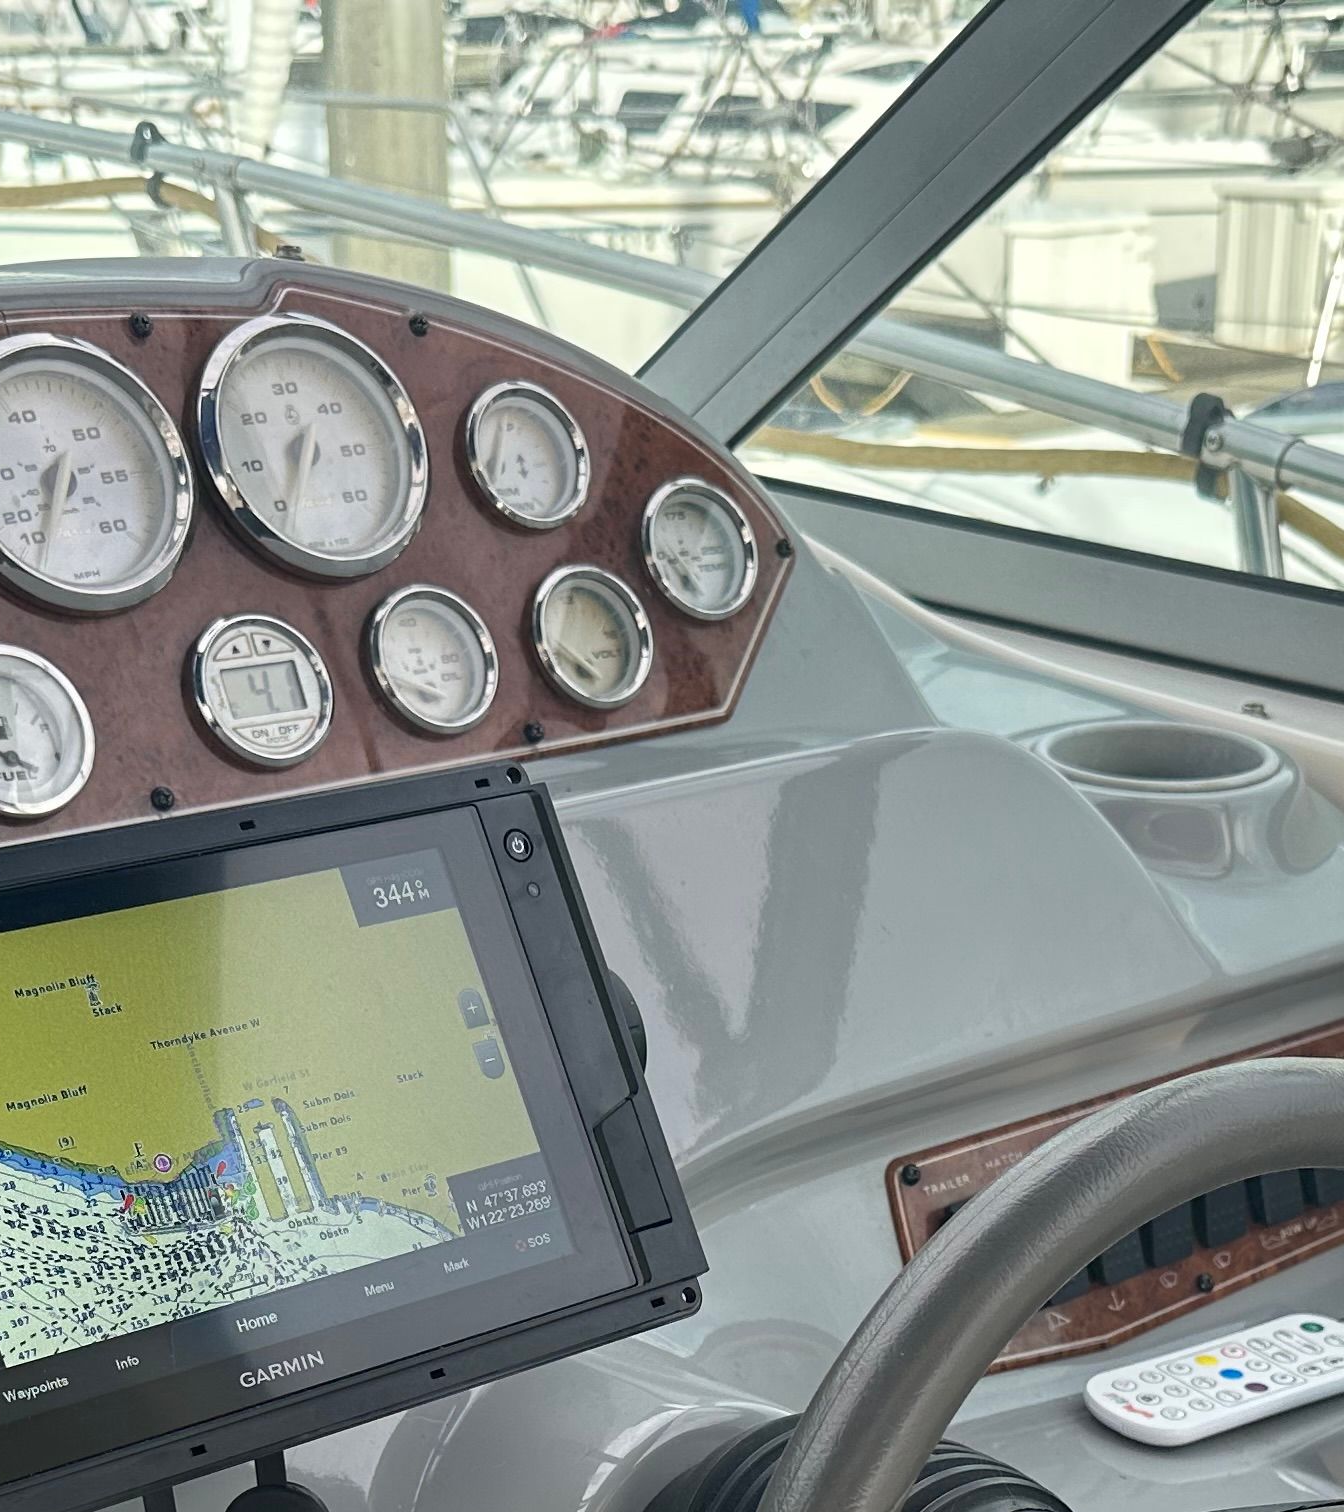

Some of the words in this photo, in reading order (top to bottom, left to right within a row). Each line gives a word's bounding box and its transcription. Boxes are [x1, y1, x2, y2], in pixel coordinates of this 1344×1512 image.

[272, 382, 298, 395] 30
[317, 402, 342, 415] 40
[8, 410, 37, 423] 40
[241, 411, 267, 425] 20
[72, 427, 101, 441] 50
[340, 444, 366, 457] 50
[241, 460, 263, 473] 10
[101, 470, 128, 484] 55
[342, 490, 367, 503] 60
[275, 500, 287, 512] 0
[3, 510, 31, 524] 20
[99, 519, 127, 534] 60
[20, 531, 46, 545] 10
[74, 570, 101, 579] MPH
[252, 728, 269, 738] ON
[278, 724, 300, 735] OFF
[14, 978, 66, 998] Magnolia
[69, 974, 96, 988] Bluff
[92, 1003, 122, 1017] Stack
[150, 1031, 207, 1050] Thorndyke
[209, 1022, 248, 1037] Avenue
[396, 1069, 426, 1085] Stack
[6, 1094, 58, 1112] Magnolia
[60, 1085, 87, 1100] Bluff
[303, 1098, 331, 1109] Subm
[334, 1090, 355, 1101] Dols
[300, 1122, 327, 1133] Subm
[330, 1115, 352, 1125] Dols
[336, 1146, 348, 1156] 89
[923, 1174, 969, 1196] TRAILER
[466, 1200, 478, 1213] N
[288, 1212, 319, 1229] Obstn
[319, 1227, 349, 1240] Obstn
[528, 1233, 550, 1248] SOS
[444, 1258, 469, 1274] Mark
[364, 1280, 394, 1297] Menu
[236, 1311, 278, 1333] Home
[115, 1355, 140, 1371] Info
[240, 1351, 325, 1389] GARMIN
[3, 1375, 69, 1403] Waypoints
